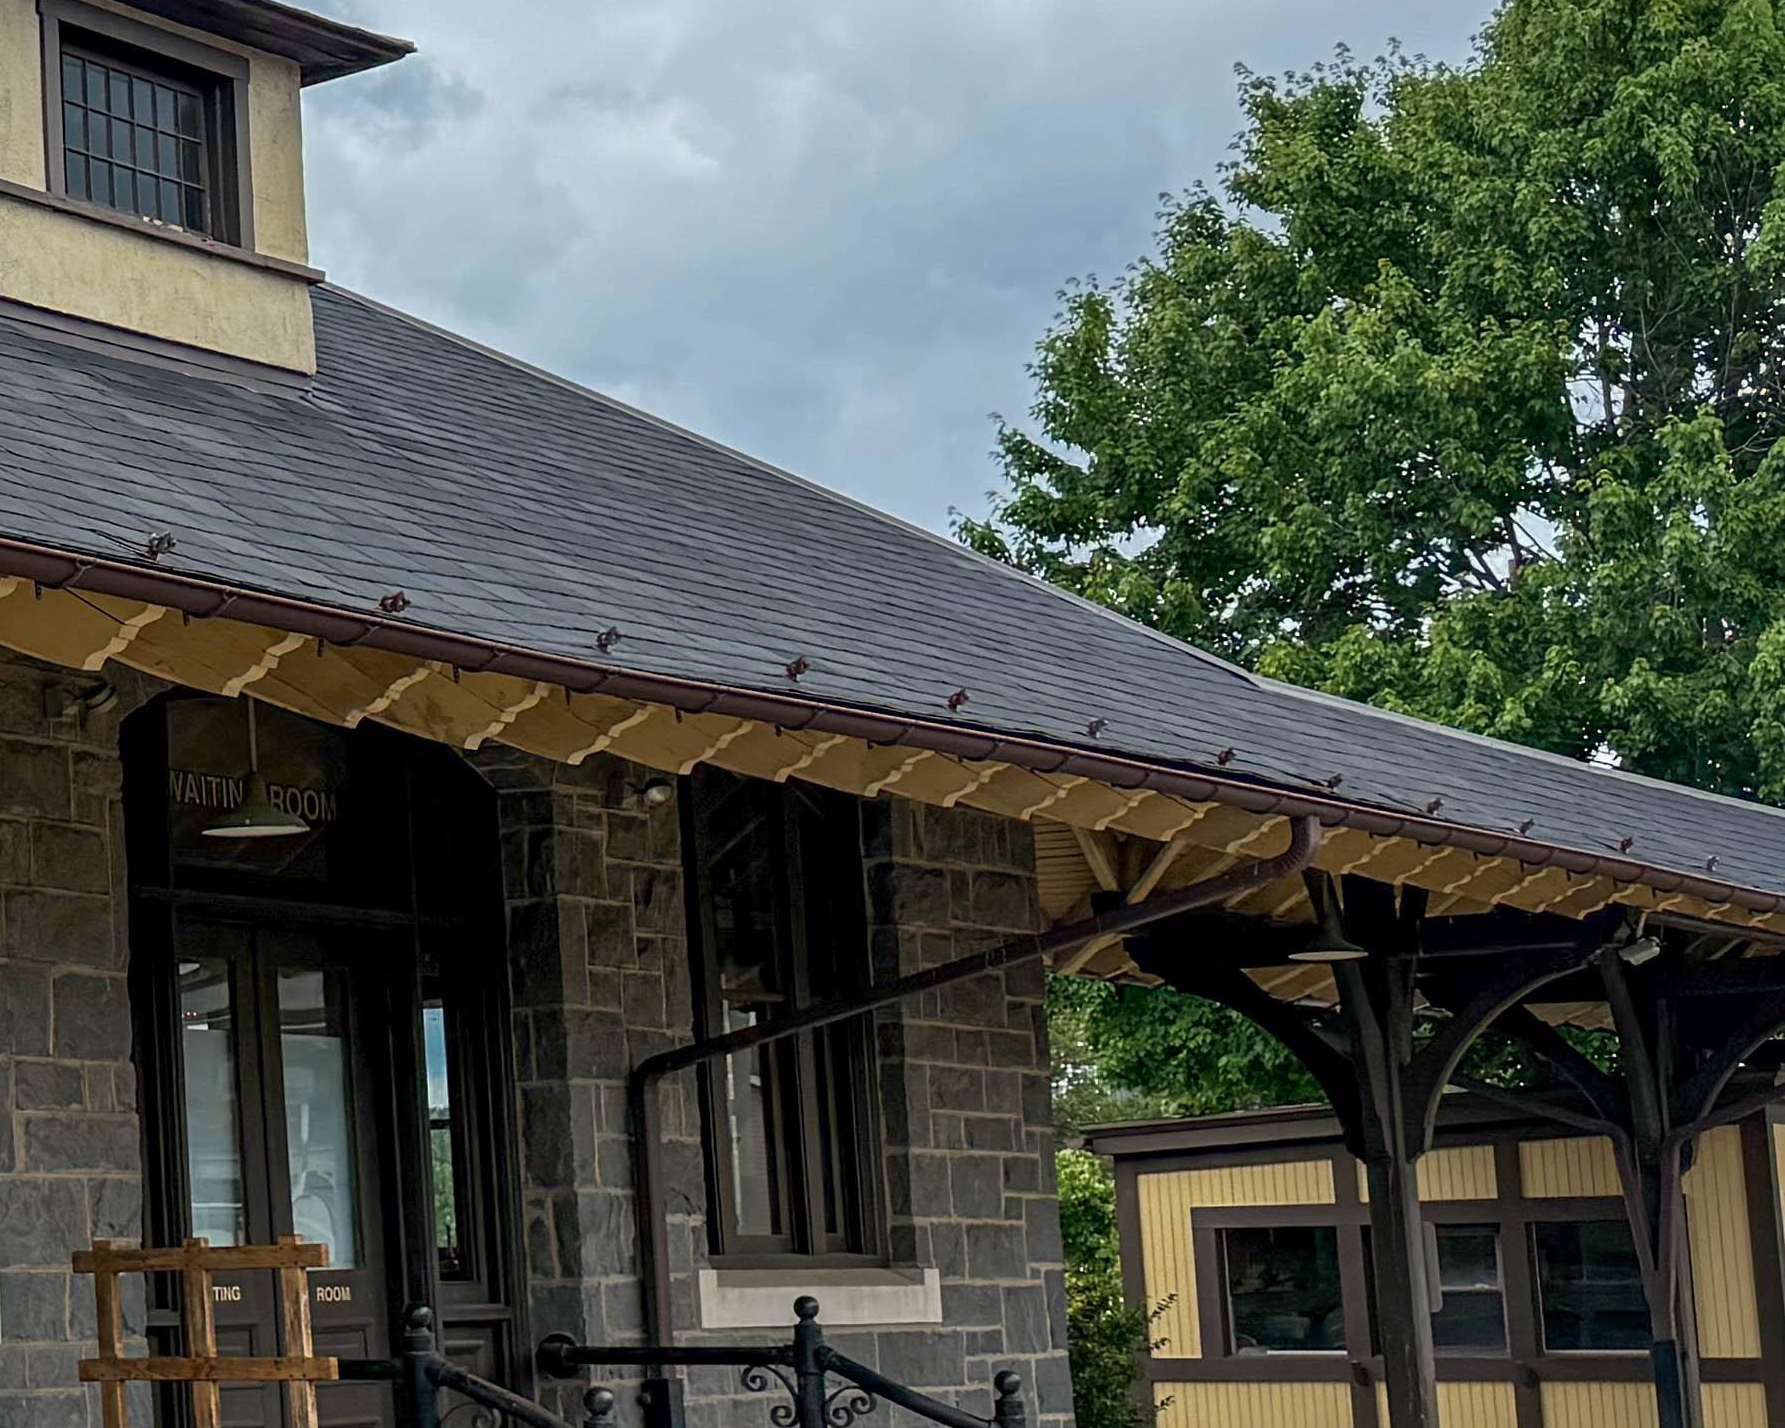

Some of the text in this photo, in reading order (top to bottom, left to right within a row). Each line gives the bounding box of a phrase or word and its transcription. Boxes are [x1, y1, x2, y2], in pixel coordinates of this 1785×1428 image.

[169, 770, 337, 821] WAITIN ROOM
[212, 1285, 351, 1302] TING ROOM
